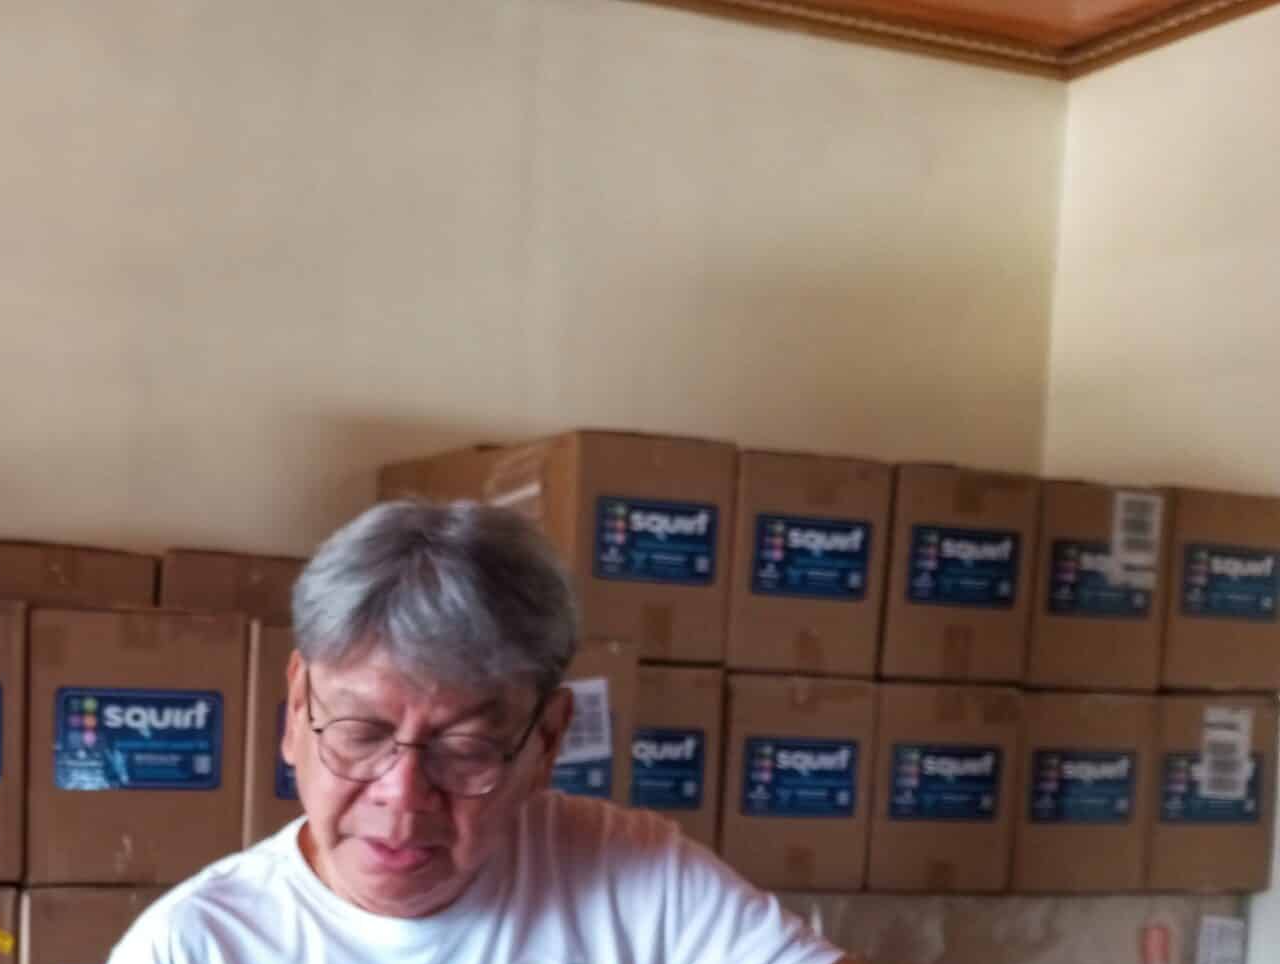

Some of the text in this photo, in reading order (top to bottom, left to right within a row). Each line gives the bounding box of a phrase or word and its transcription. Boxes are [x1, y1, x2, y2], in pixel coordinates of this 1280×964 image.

[629, 510, 711, 543] squirt
[787, 525, 865, 558] squirt
[941, 537, 1013, 566] squirt
[102, 702, 210, 737] squirt
[775, 747, 852, 778] squirt
[922, 750, 995, 784] squirt
